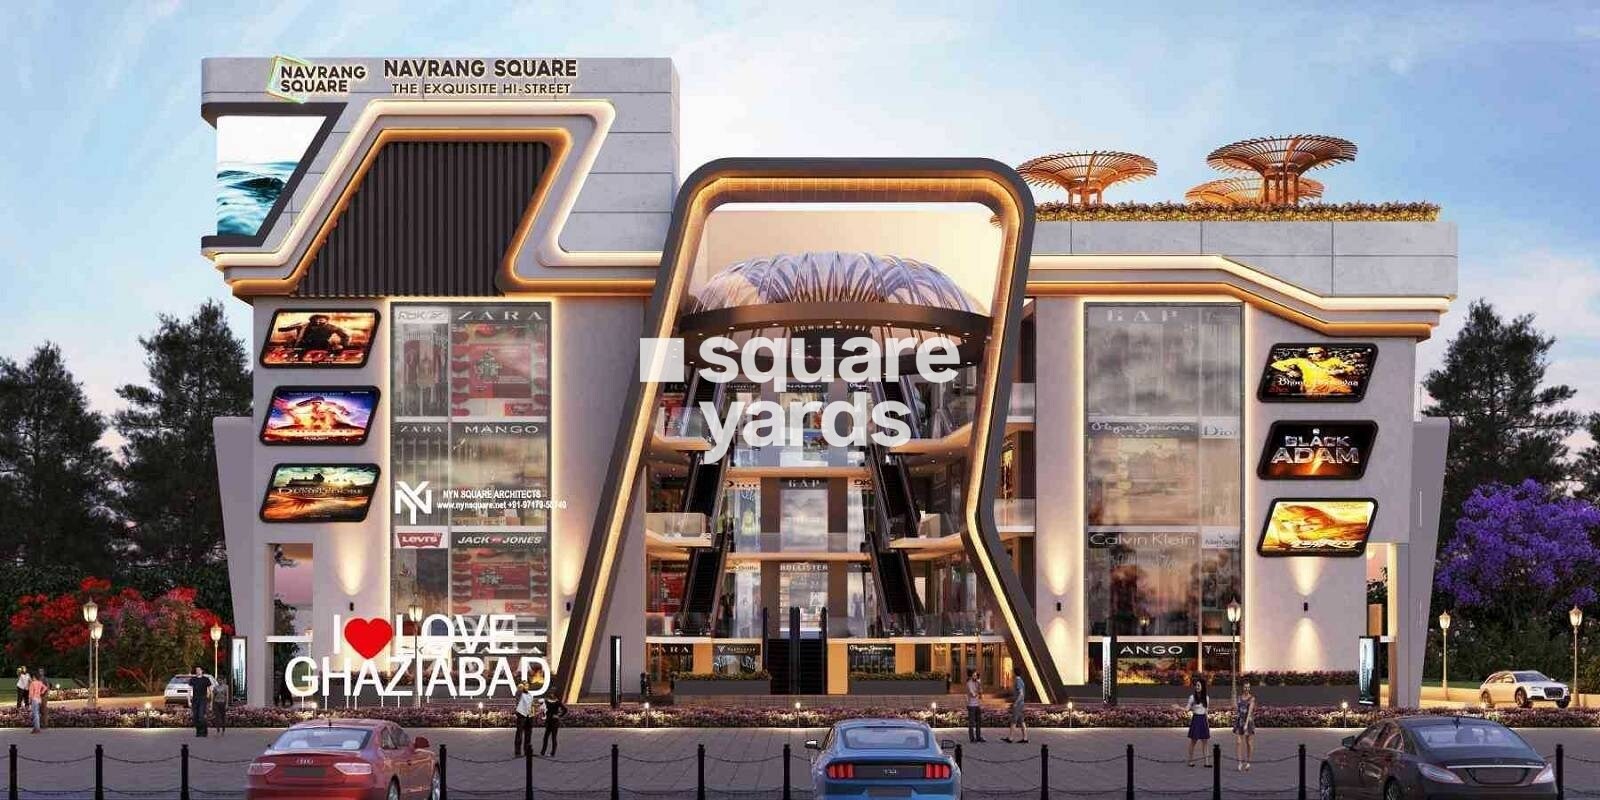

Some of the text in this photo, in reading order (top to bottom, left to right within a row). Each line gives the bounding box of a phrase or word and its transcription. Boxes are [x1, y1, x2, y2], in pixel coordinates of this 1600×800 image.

[280, 65, 367, 79] NAVRANG
[384, 59, 577, 77] NAVRANG SQUARE
[280, 79, 348, 93] SQUARE
[392, 83, 571, 95] THE EXQUISITE HI-STREET
[457, 310, 544, 321] ZARA
[464, 424, 539, 434] MANGO
[1204, 425, 1237, 437] Dio
[1284, 435, 1351, 447] BLACK
[1270, 447, 1360, 464] ADAM
[457, 536, 543, 544] JACK JONES
[1089, 533, 1148, 545] Calvin
[333, 612, 517, 655] I LOVE
[1120, 645, 1184, 655] ANGO
[284, 655, 551, 698] GHAZIABAD
